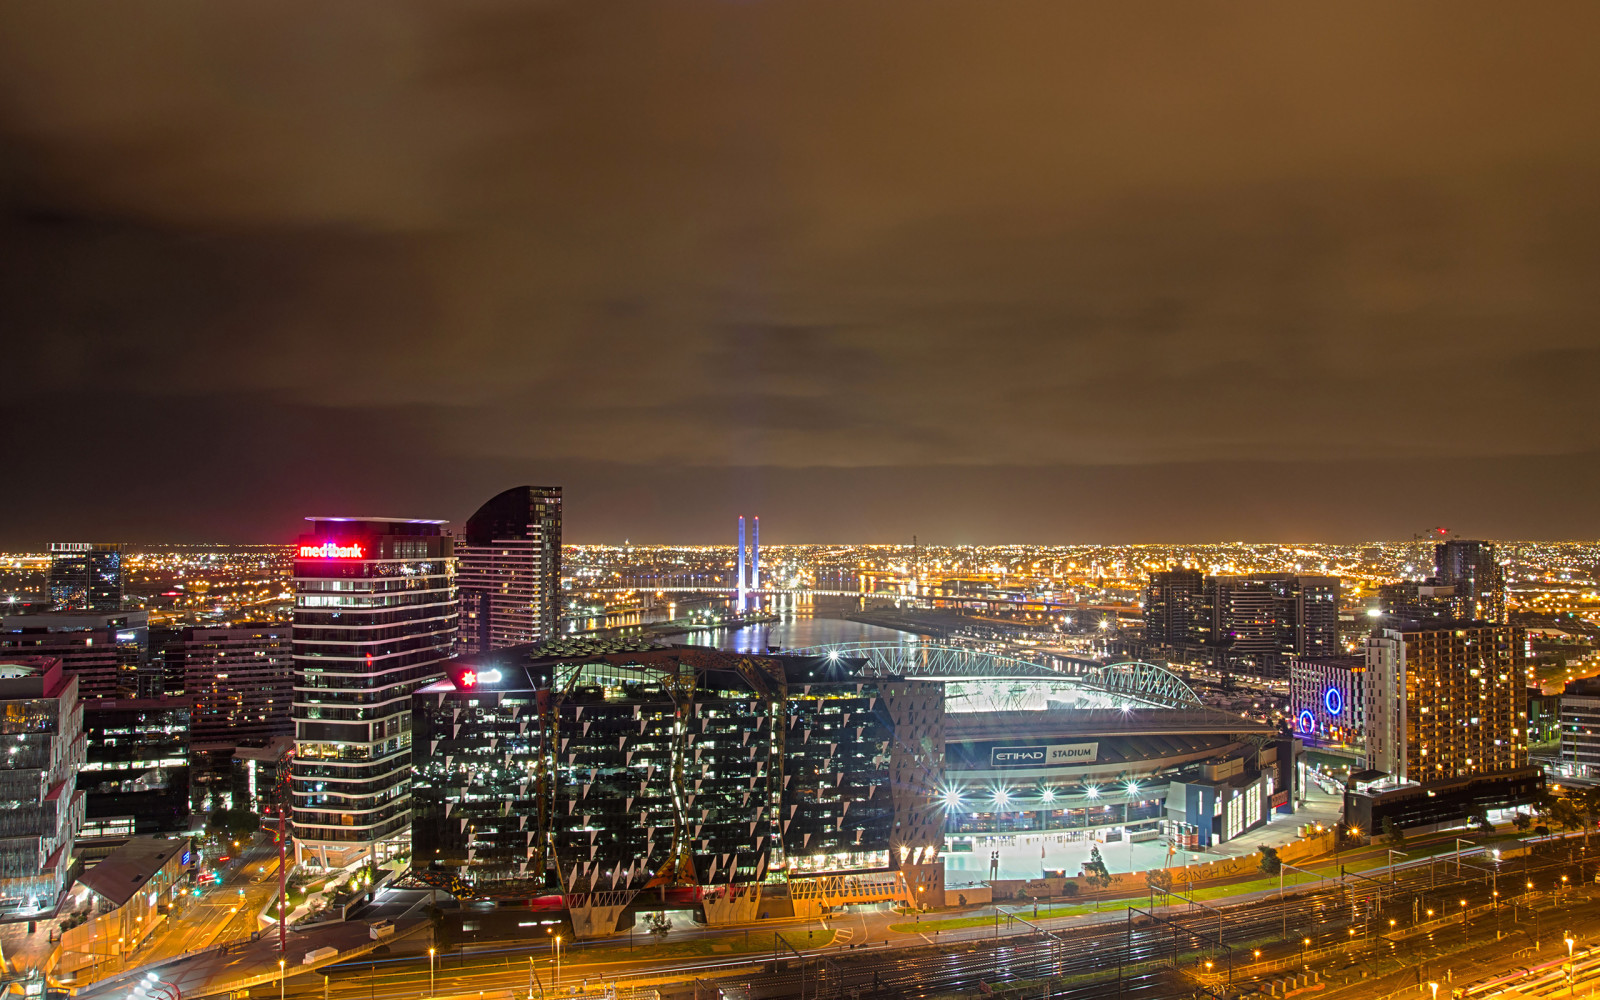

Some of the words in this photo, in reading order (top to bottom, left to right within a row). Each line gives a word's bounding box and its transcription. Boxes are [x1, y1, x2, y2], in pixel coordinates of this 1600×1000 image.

[300, 543, 363, 558] medibank
[996, 752, 1044, 760] ETIHAD
[1052, 749, 1091, 758] STADIUM
